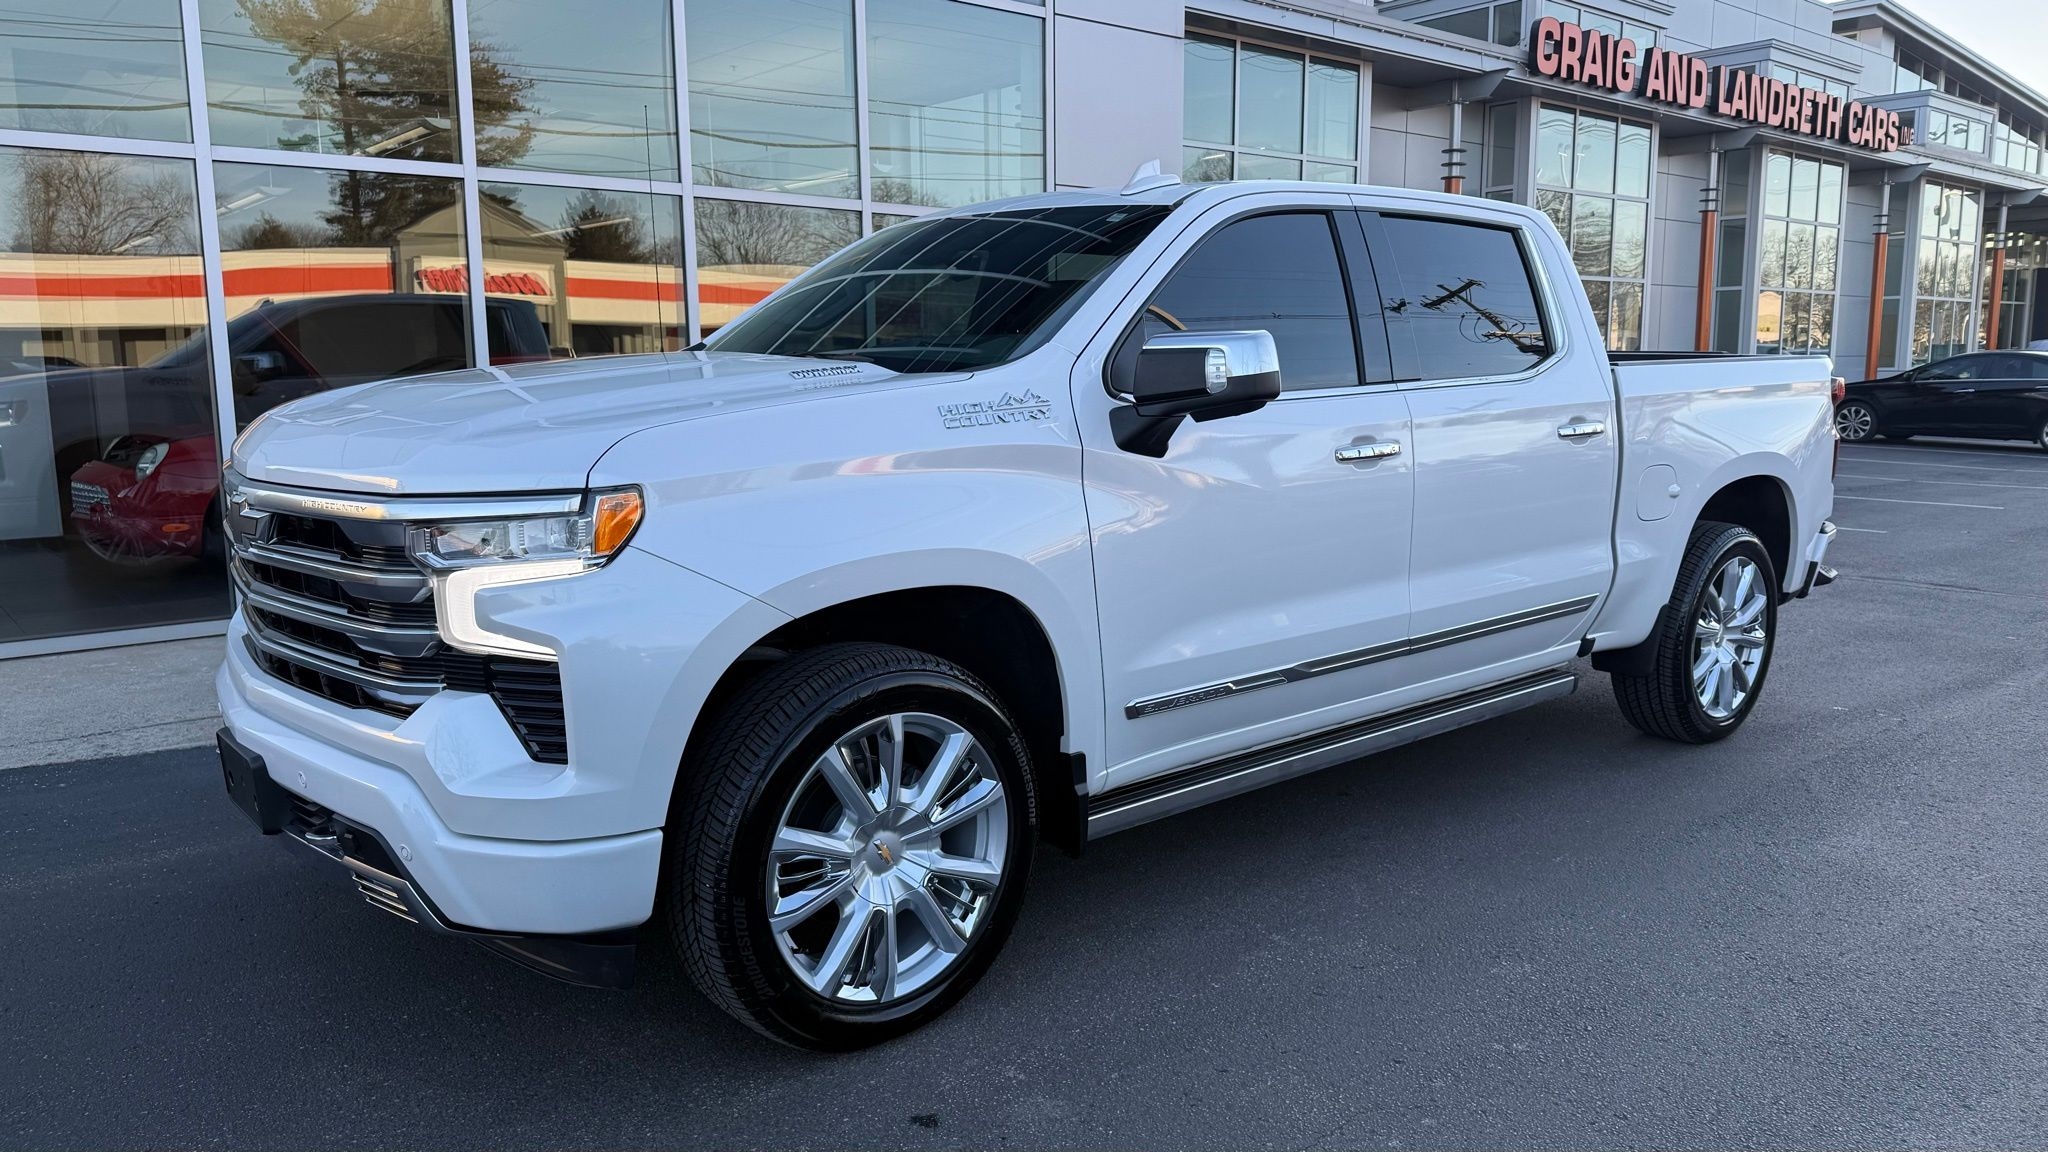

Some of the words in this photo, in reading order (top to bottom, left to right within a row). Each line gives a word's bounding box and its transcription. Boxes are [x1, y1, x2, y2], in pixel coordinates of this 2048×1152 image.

[1533, 16, 1637, 93] CRAIG
[1643, 46, 1708, 109] AND
[1715, 64, 1842, 140] LANDRETH
[1846, 100, 1900, 152] CARS
[937, 400, 994, 417] HIGH
[943, 407, 1052, 429] COUNTRY
[323, 501, 368, 514] COUNTRY
[1007, 731, 1037, 826] BRIDGESTONE
